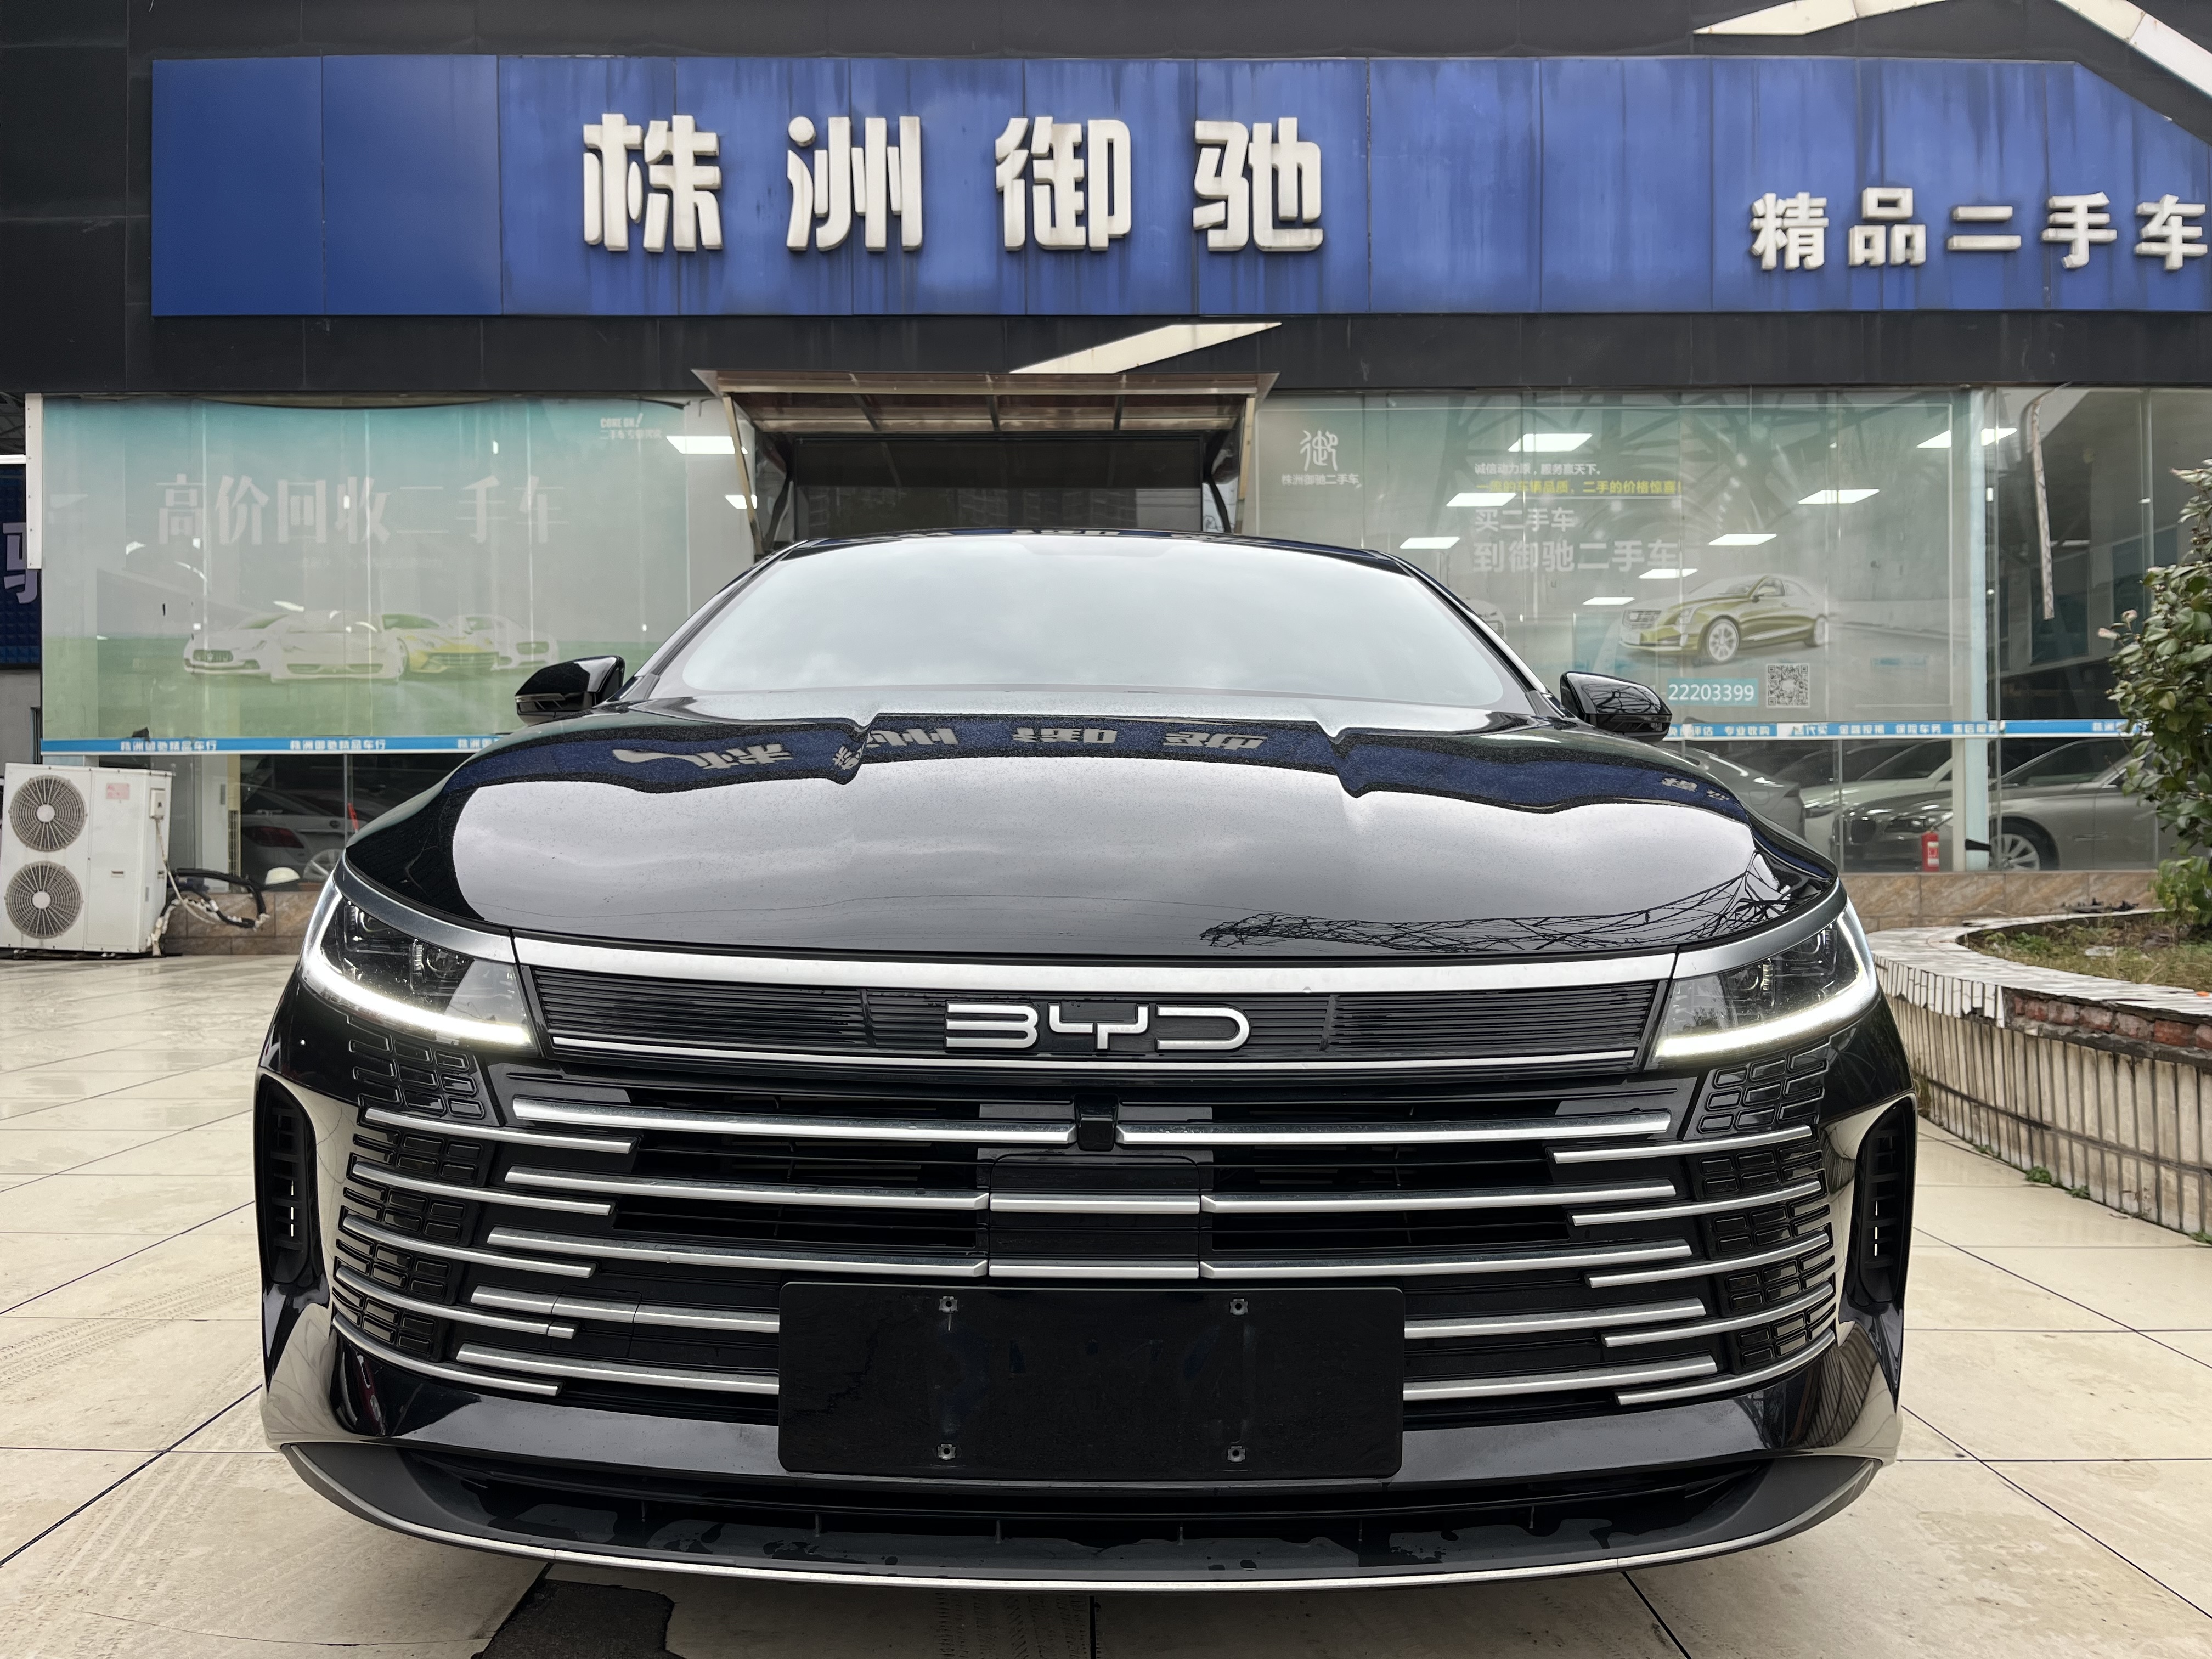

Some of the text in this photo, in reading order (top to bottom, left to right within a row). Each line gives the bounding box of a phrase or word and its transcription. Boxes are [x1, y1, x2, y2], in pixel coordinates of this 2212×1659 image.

[583, 113, 1324, 252] 株洲御驰
[1750, 187, 2208, 270] 精品二手车
[1281, 473, 1359, 486] 株洲御驰二手车
[156, 473, 571, 545] 高价回收二手车
[1474, 507, 1575, 532] 买二手车
[1473, 539, 1680, 573] 到御驰二手车
[945, 1003, 1252, 1050] BYD
